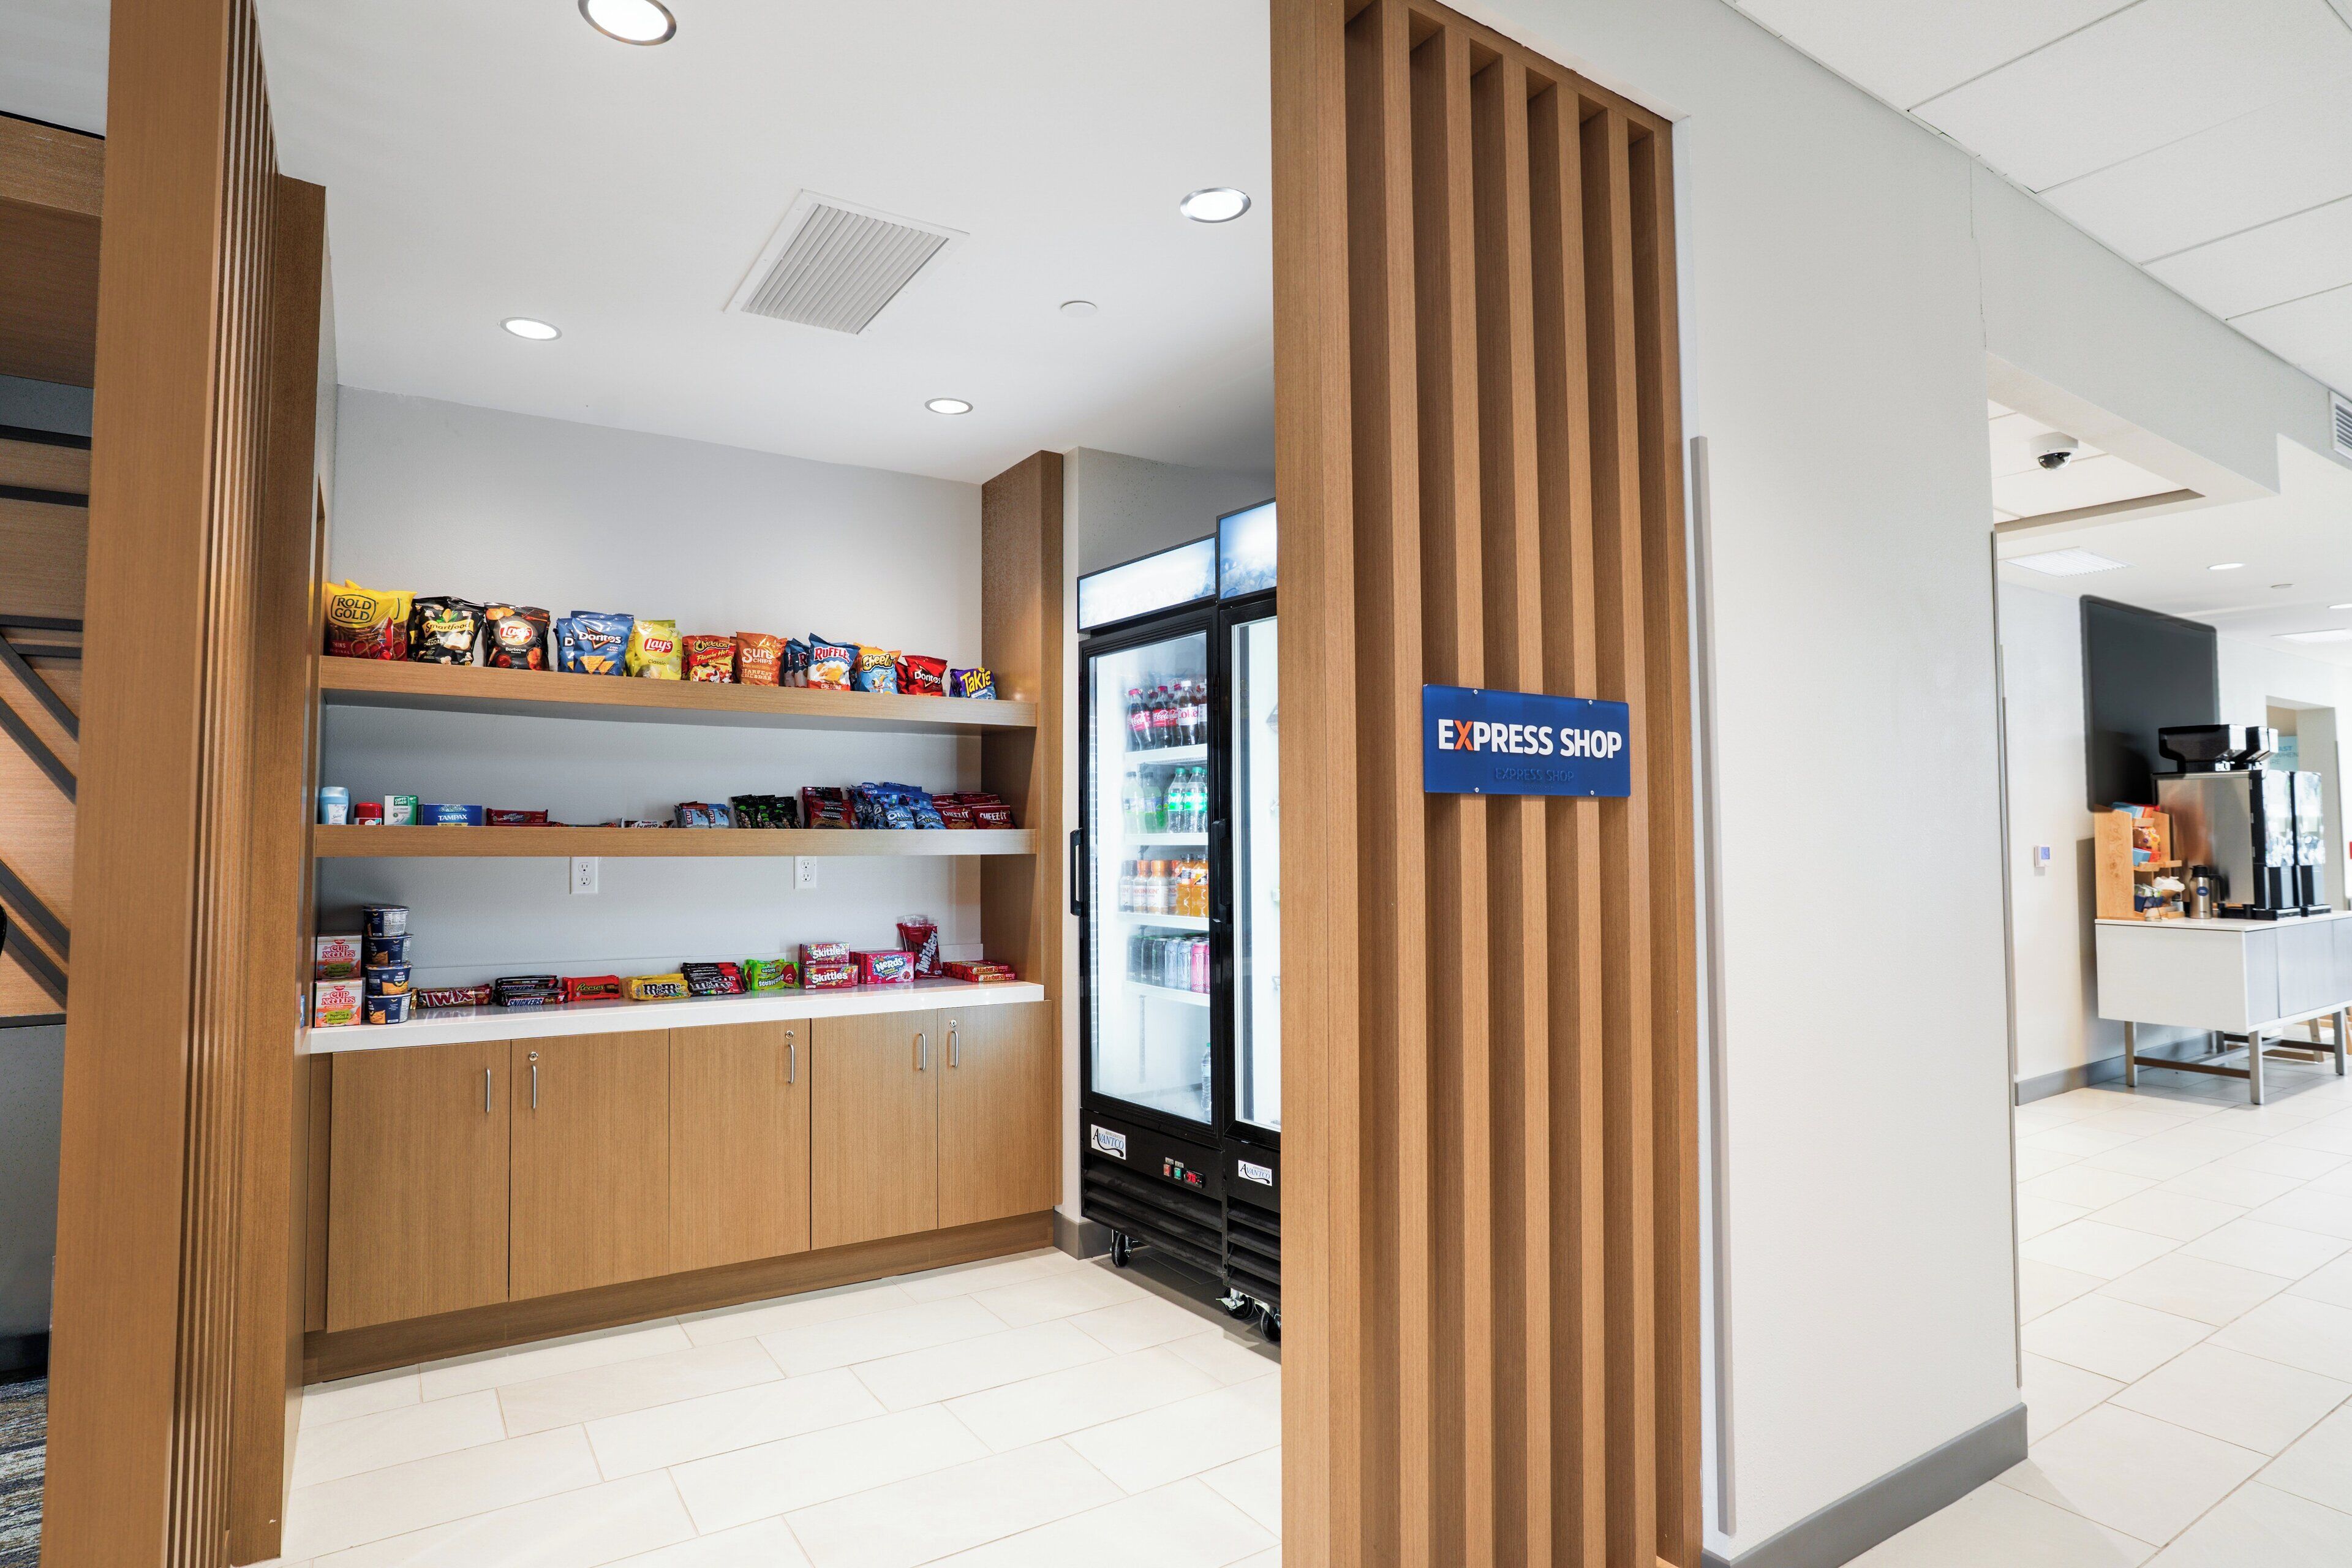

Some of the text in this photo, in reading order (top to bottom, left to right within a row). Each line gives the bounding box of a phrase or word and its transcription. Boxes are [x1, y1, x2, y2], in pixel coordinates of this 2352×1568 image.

[337, 597, 372, 610] ROLD
[334, 608, 370, 620] GOLD
[426, 621, 471, 633] Smartfood
[578, 631, 622, 644] Doritos
[695, 640, 729, 651] Cheetos
[742, 648, 772, 663] Sun
[914, 671, 941, 685] Doritos
[960, 668, 991, 697] Takis
[1438, 718, 1623, 759] EXPRESS SHOP
[1495, 767, 1575, 782] EXPRESS SHOP
[322, 950, 356, 959] NOODLES
[812, 944, 846, 959] Skittles
[812, 971, 848, 984] Skittles
[576, 982, 605, 991] Reese's
[321, 997, 356, 1005] NOODLES
[424, 989, 473, 1007] TWIX
[509, 998, 543, 1006] SNICKERS
[1093, 1128, 1124, 1152] AVANTCO
[1240, 1164, 1270, 1180] AVANTCO
